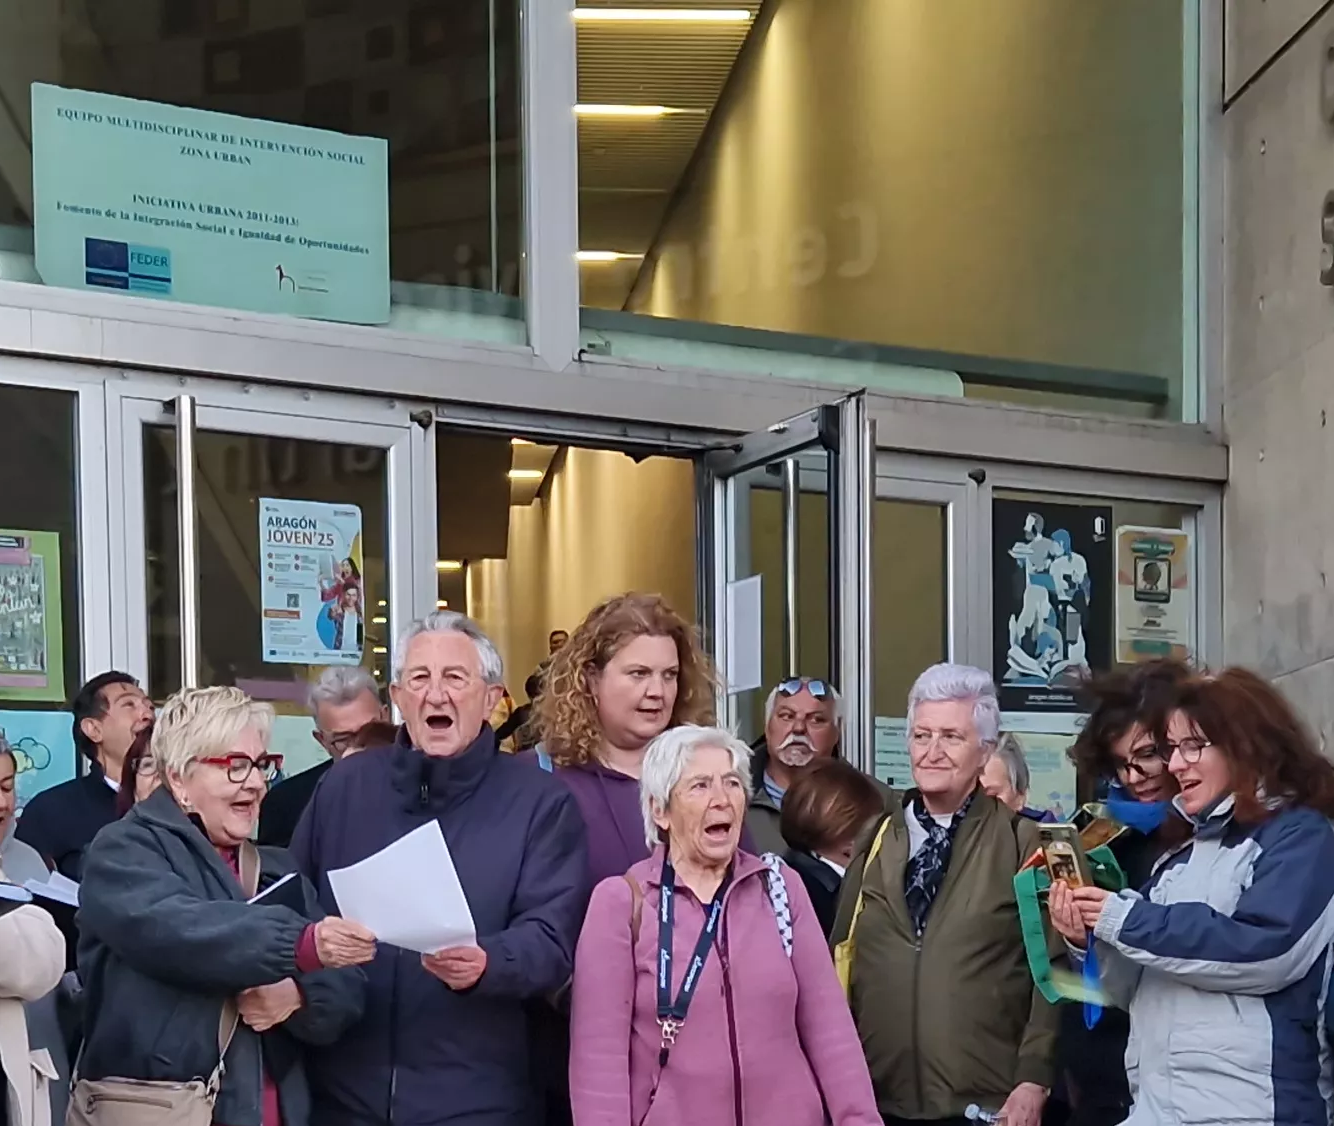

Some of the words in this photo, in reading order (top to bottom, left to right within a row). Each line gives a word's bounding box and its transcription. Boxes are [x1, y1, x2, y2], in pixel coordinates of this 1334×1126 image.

[56, 107, 103, 123] EQUIPO
[107, 115, 218, 142] MULTIDISCIPLINAR
[221, 133, 237, 145] DE
[240, 136, 324, 158] INTERVENCIÓN
[327, 150, 366, 165] SOCIAL
[180, 146, 211, 159] ZONA
[214, 151, 252, 165] URBAN
[133, 194, 196, 212] INICIATIVA
[199, 202, 244, 219] URBANA
[56, 200, 102, 216] Fomento
[105, 208, 117, 219] de
[120, 211, 130, 221] la
[133, 212, 193, 229] Integración
[196, 222, 226, 234] Social
[230, 228, 235, 236] e
[239, 227, 282, 243] Igualdad
[285, 234, 296, 244] de
[299, 237, 370, 254] Oportunidades
[130, 252, 168, 267] FEDER
[267, 515, 317, 529] ARAGÓN
[267, 530, 334, 546] JOVEN'25
